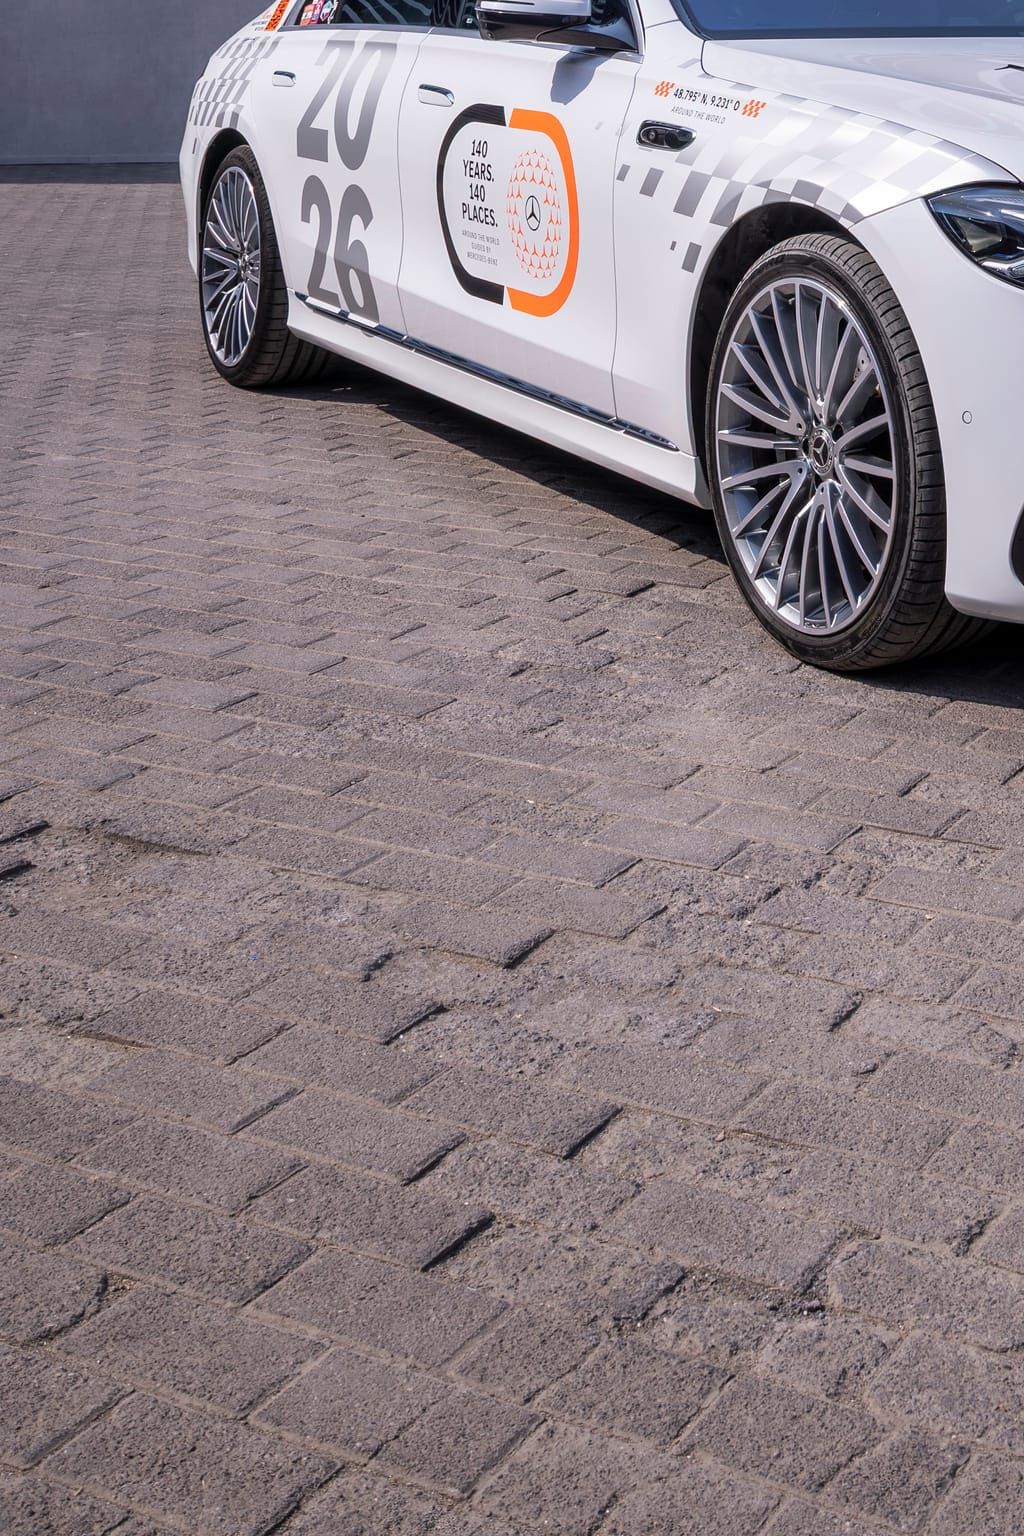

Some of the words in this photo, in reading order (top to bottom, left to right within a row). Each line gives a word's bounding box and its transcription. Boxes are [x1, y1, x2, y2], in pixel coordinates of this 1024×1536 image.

[296, 32, 400, 171] 20
[471, 139, 488, 158] 140
[463, 159, 495, 182] YEARS.
[469, 182, 486, 201] 140
[461, 202, 499, 227] PLACES.
[300, 174, 380, 323] 26
